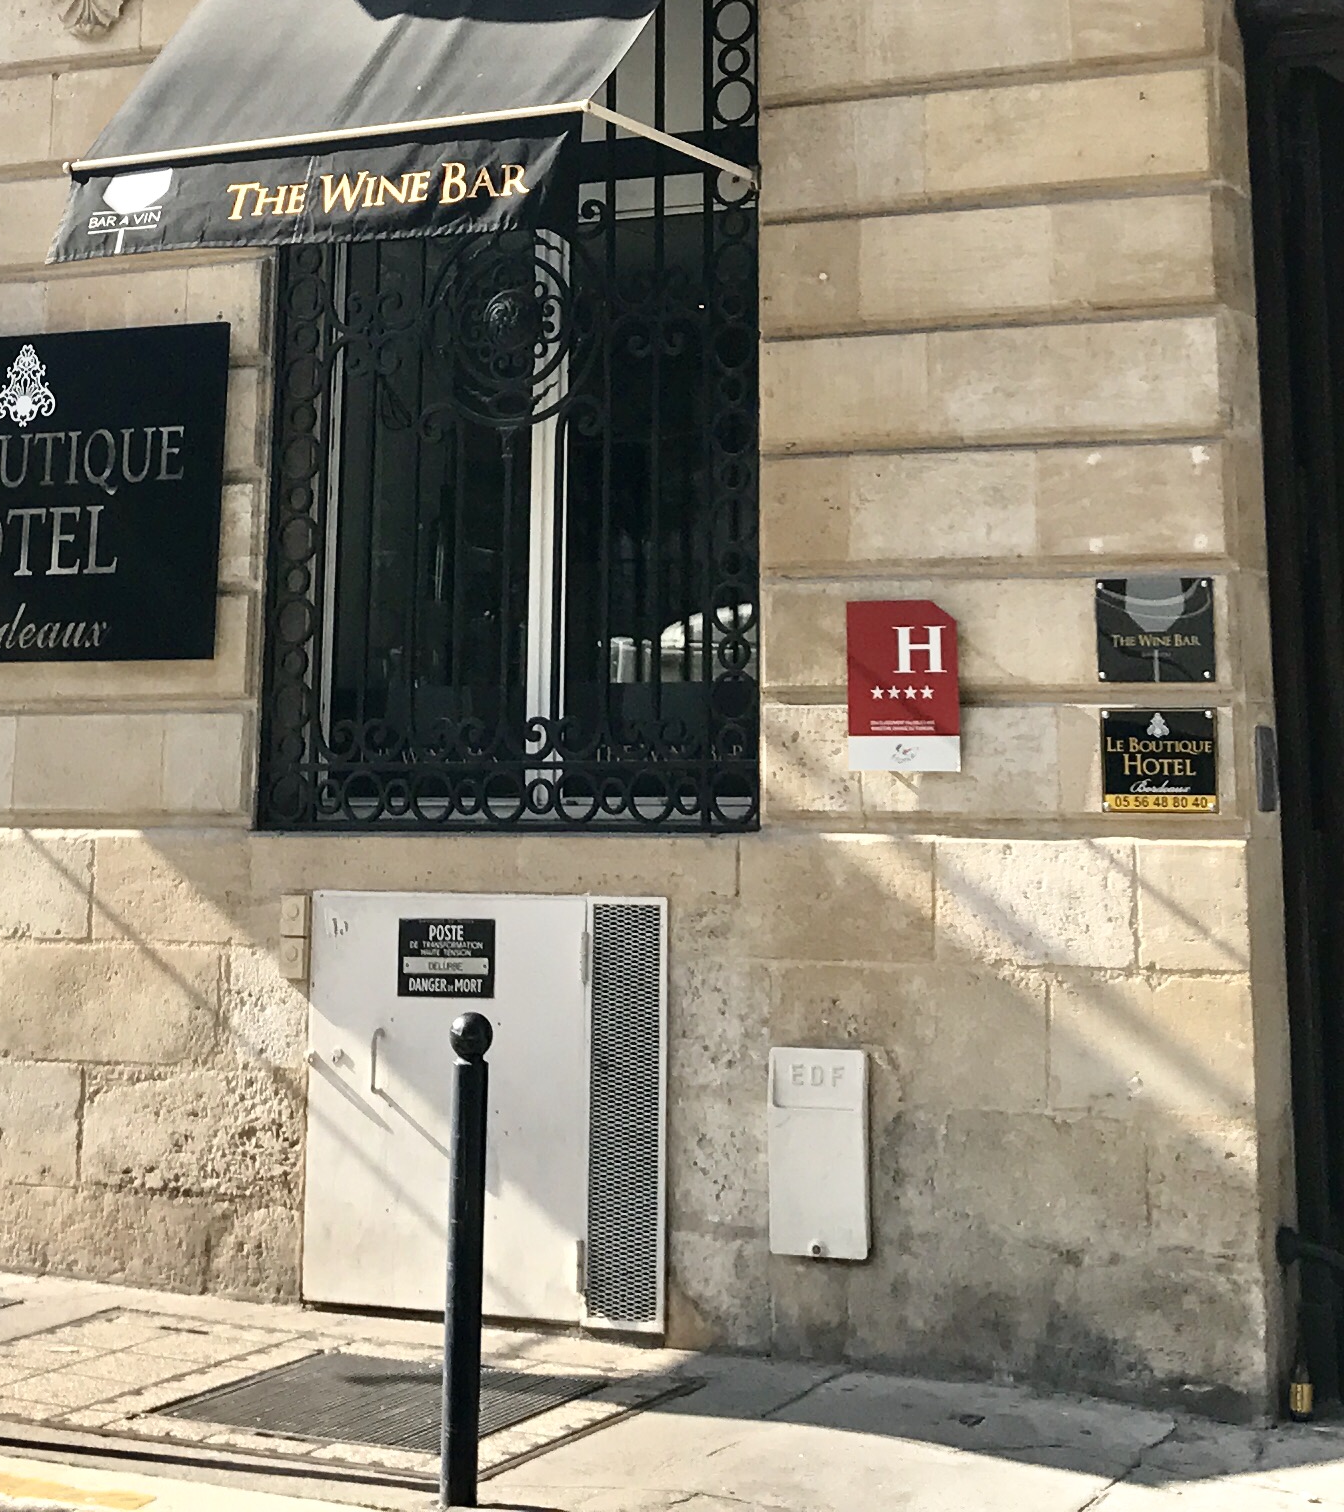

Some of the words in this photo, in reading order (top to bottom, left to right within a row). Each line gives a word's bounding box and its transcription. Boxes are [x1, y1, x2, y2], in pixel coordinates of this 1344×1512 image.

[227, 181, 306, 221] THE
[319, 170, 431, 215] WINE
[440, 161, 530, 204] BAR
[88, 216, 117, 229] BAR
[134, 210, 162, 225] VIN
[1111, 634, 1136, 648] THE
[1138, 633, 1171, 647] WINE
[1174, 633, 1201, 647] BAR
[891, 625, 948, 674] H
[1106, 737, 1124, 752] LE
[1129, 737, 1213, 755] BOUTIQUE
[1123, 753, 1197, 776] HOTEL
[1130, 778, 1191, 793] Bordeaux
[1114, 796, 1130, 808] 05
[1134, 796, 1150, 808] 56
[1153, 796, 1168, 808] 48
[1173, 796, 1188, 808] 80
[1191, 796, 1208, 809] 40
[429, 924, 464, 941] POSTE
[422, 940, 484, 950] TRANSFORMATION
[443, 948, 472, 956] TENSION
[408, 977, 447, 992] DANGER
[454, 978, 483, 993] MORT
[791, 1064, 844, 1087] EDF
